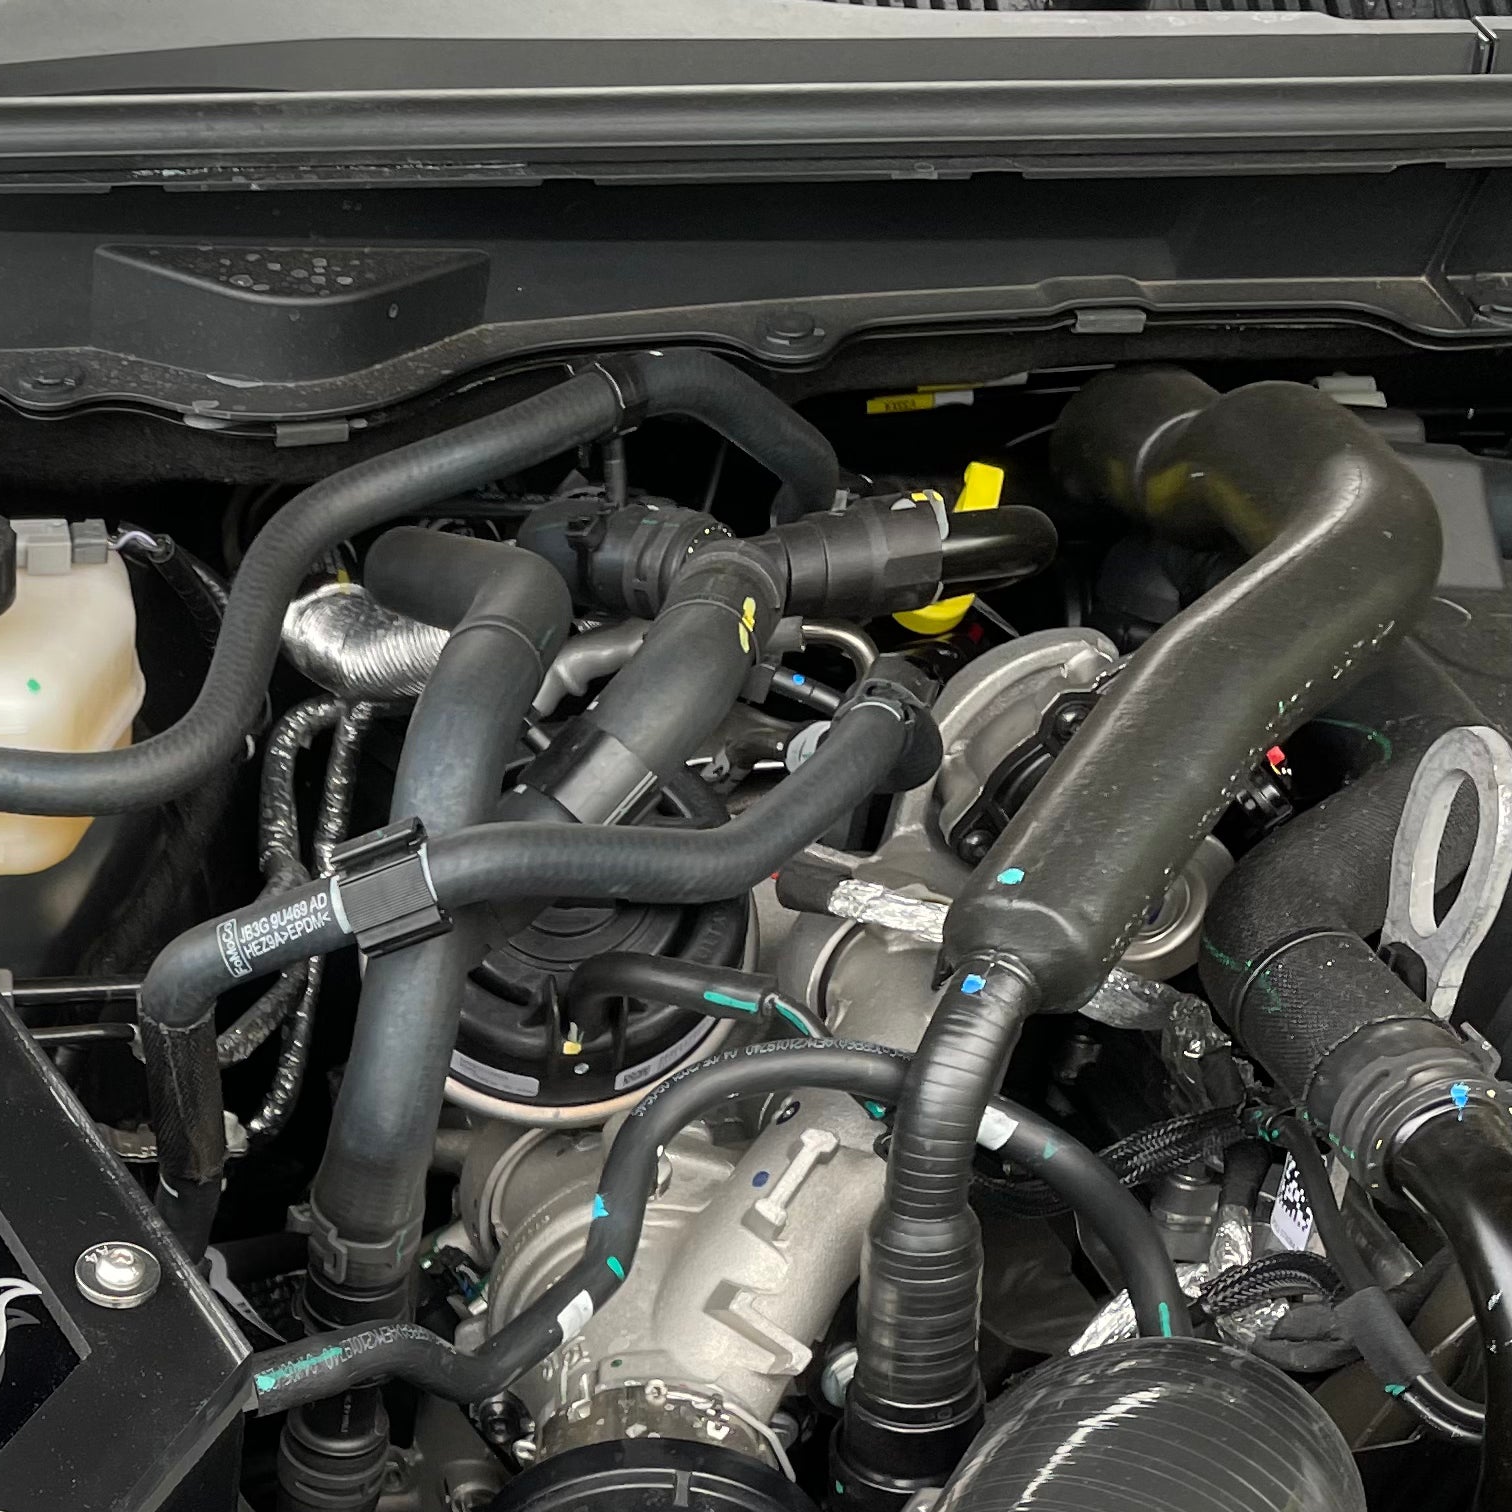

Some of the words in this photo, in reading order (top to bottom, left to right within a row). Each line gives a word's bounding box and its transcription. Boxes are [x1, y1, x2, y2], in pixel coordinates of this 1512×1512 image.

[239, 917, 269, 944] JB3G
[269, 900, 308, 929] 9U469
[309, 892, 328, 913] AD
[221, 921, 248, 976] FoMoCo
